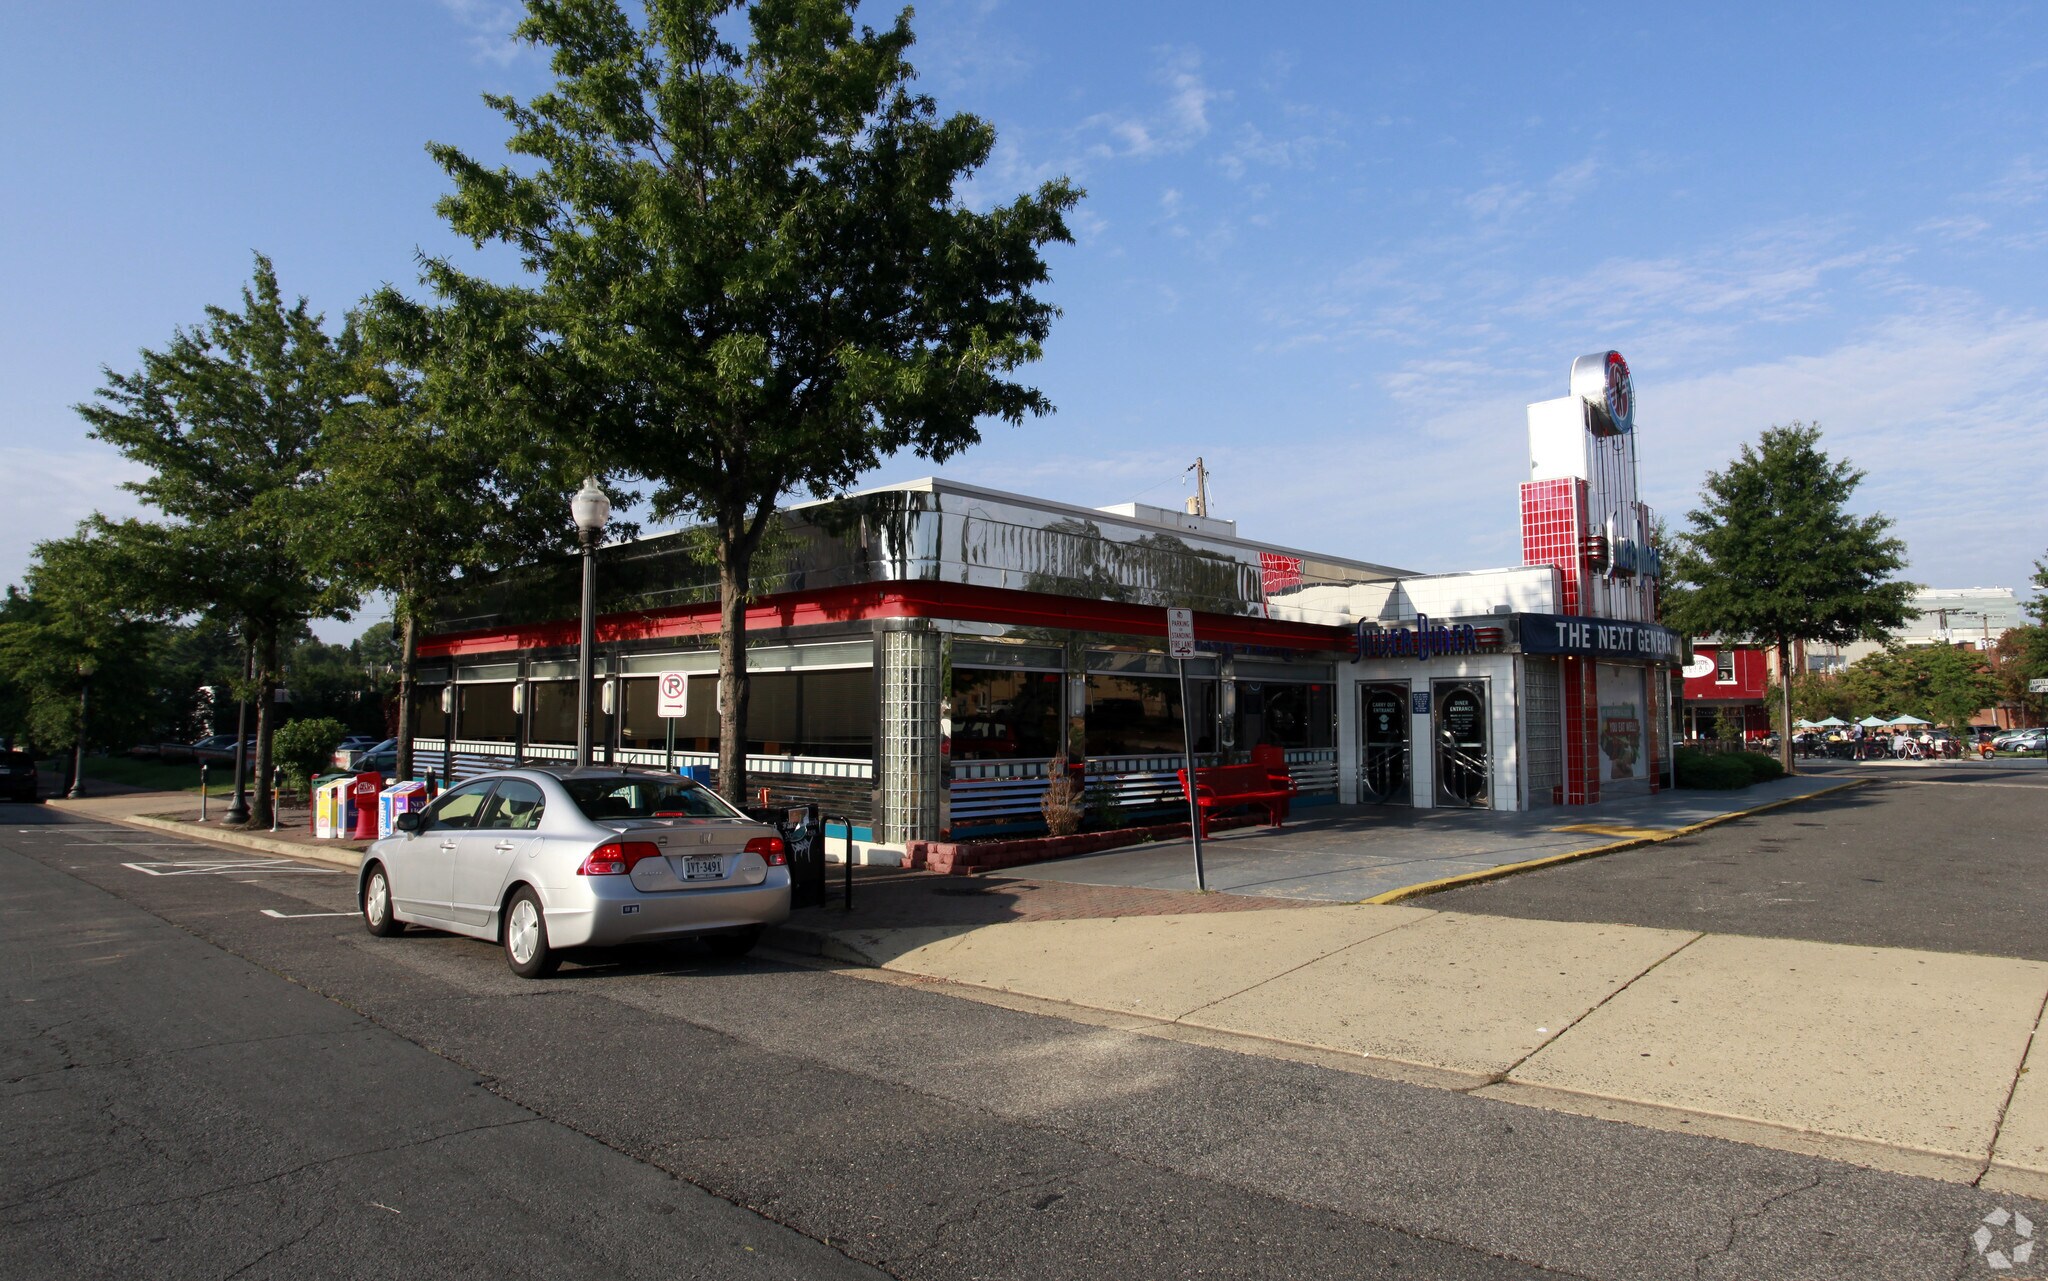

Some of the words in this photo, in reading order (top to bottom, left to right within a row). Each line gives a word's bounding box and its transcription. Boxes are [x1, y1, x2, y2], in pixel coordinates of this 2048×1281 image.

[1556, 622, 1591, 648] THE
[1598, 625, 1633, 650] NEXT
[1609, 721, 1618, 732] YOU
[687, 861, 721, 873] JVT-3491
